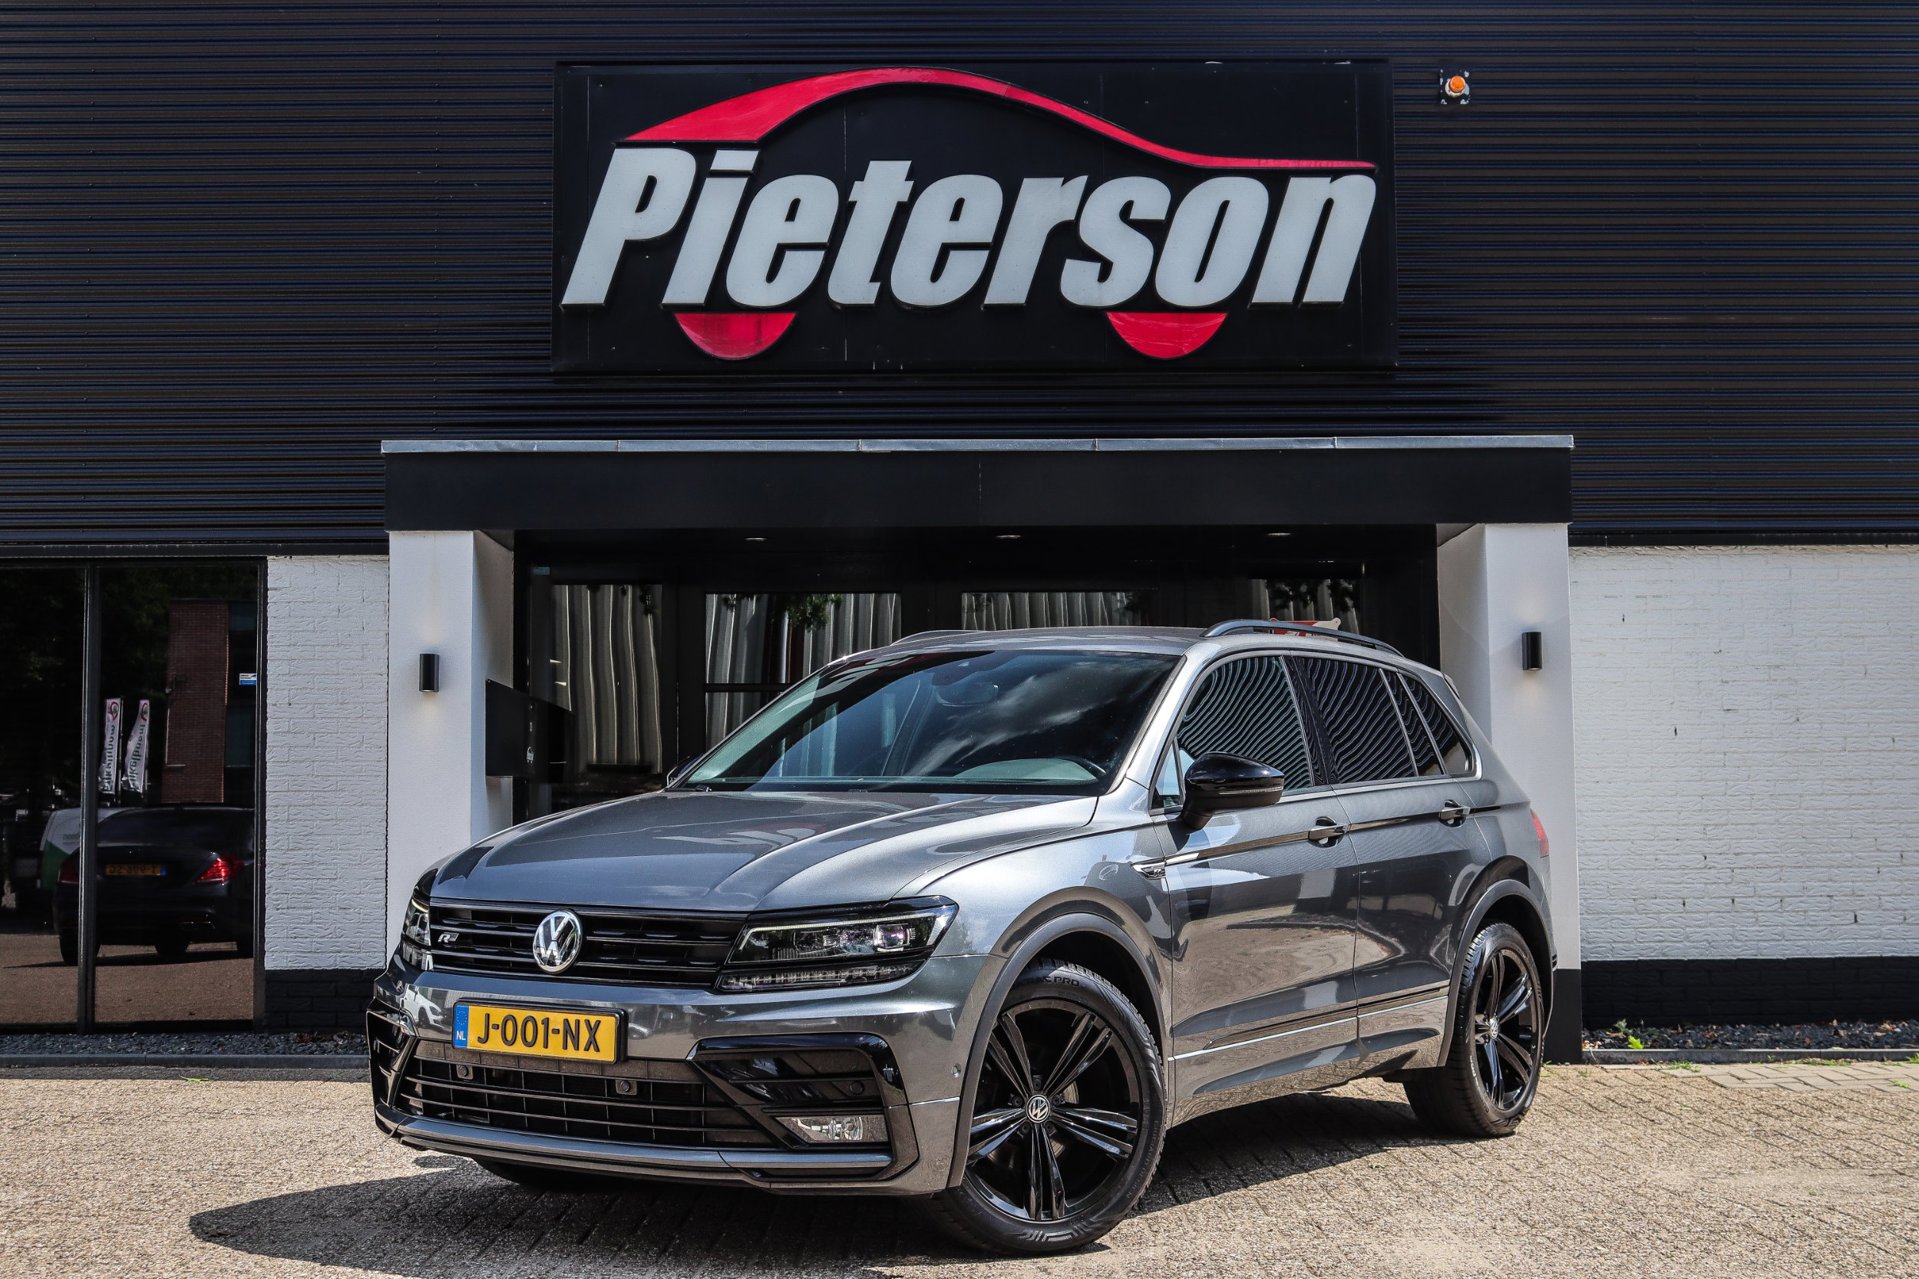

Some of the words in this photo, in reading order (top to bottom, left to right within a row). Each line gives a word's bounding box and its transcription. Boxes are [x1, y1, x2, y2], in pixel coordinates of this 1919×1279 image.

[560, 147, 1378, 308] Pieterson
[1053, 976, 1080, 987] PRO
[456, 1030, 467, 1041] NL
[477, 1012, 602, 1053] J-001-NX
